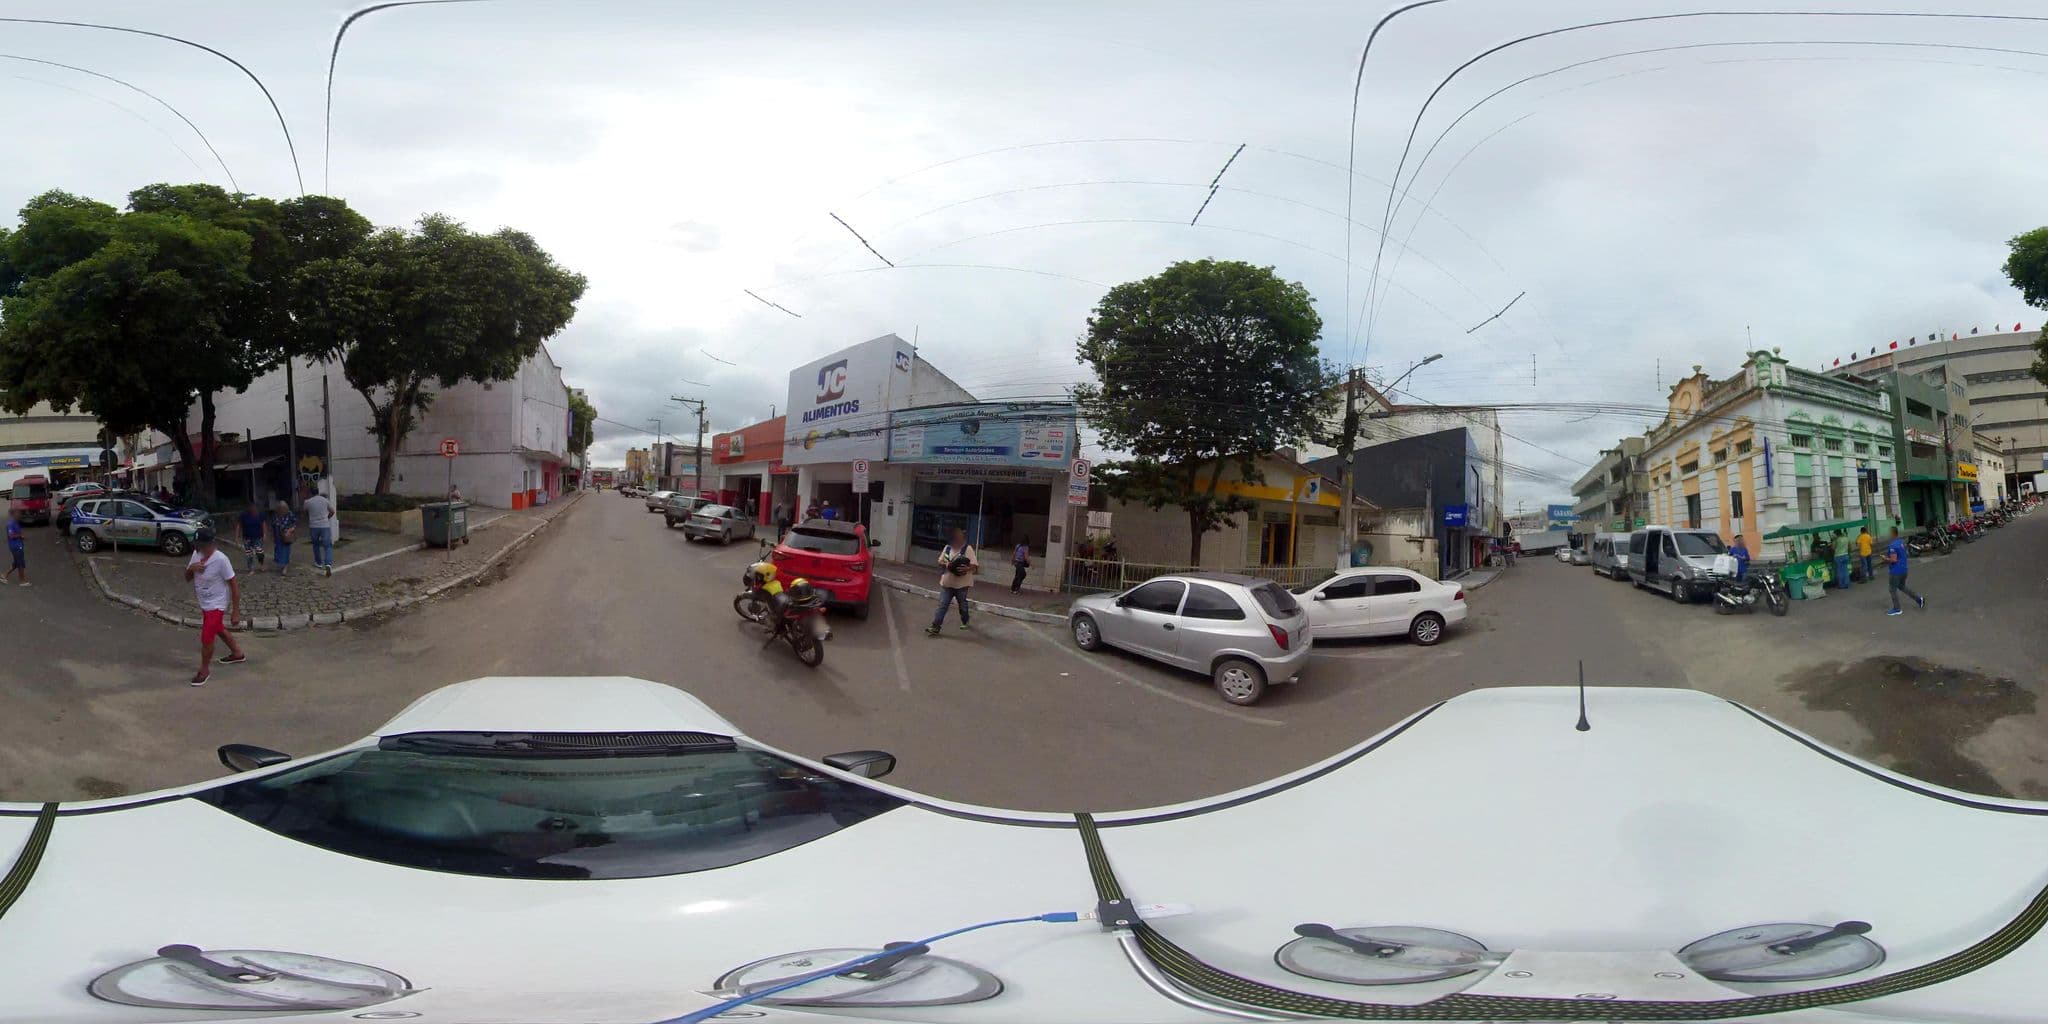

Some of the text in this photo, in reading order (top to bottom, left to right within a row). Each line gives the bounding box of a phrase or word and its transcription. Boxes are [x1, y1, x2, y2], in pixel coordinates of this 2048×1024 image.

[896, 352, 910, 371] JC
[816, 363, 848, 400] JC
[802, 399, 860, 423] ALIMENTOS
[858, 463, 864, 471] E
[1077, 464, 1083, 475] E
